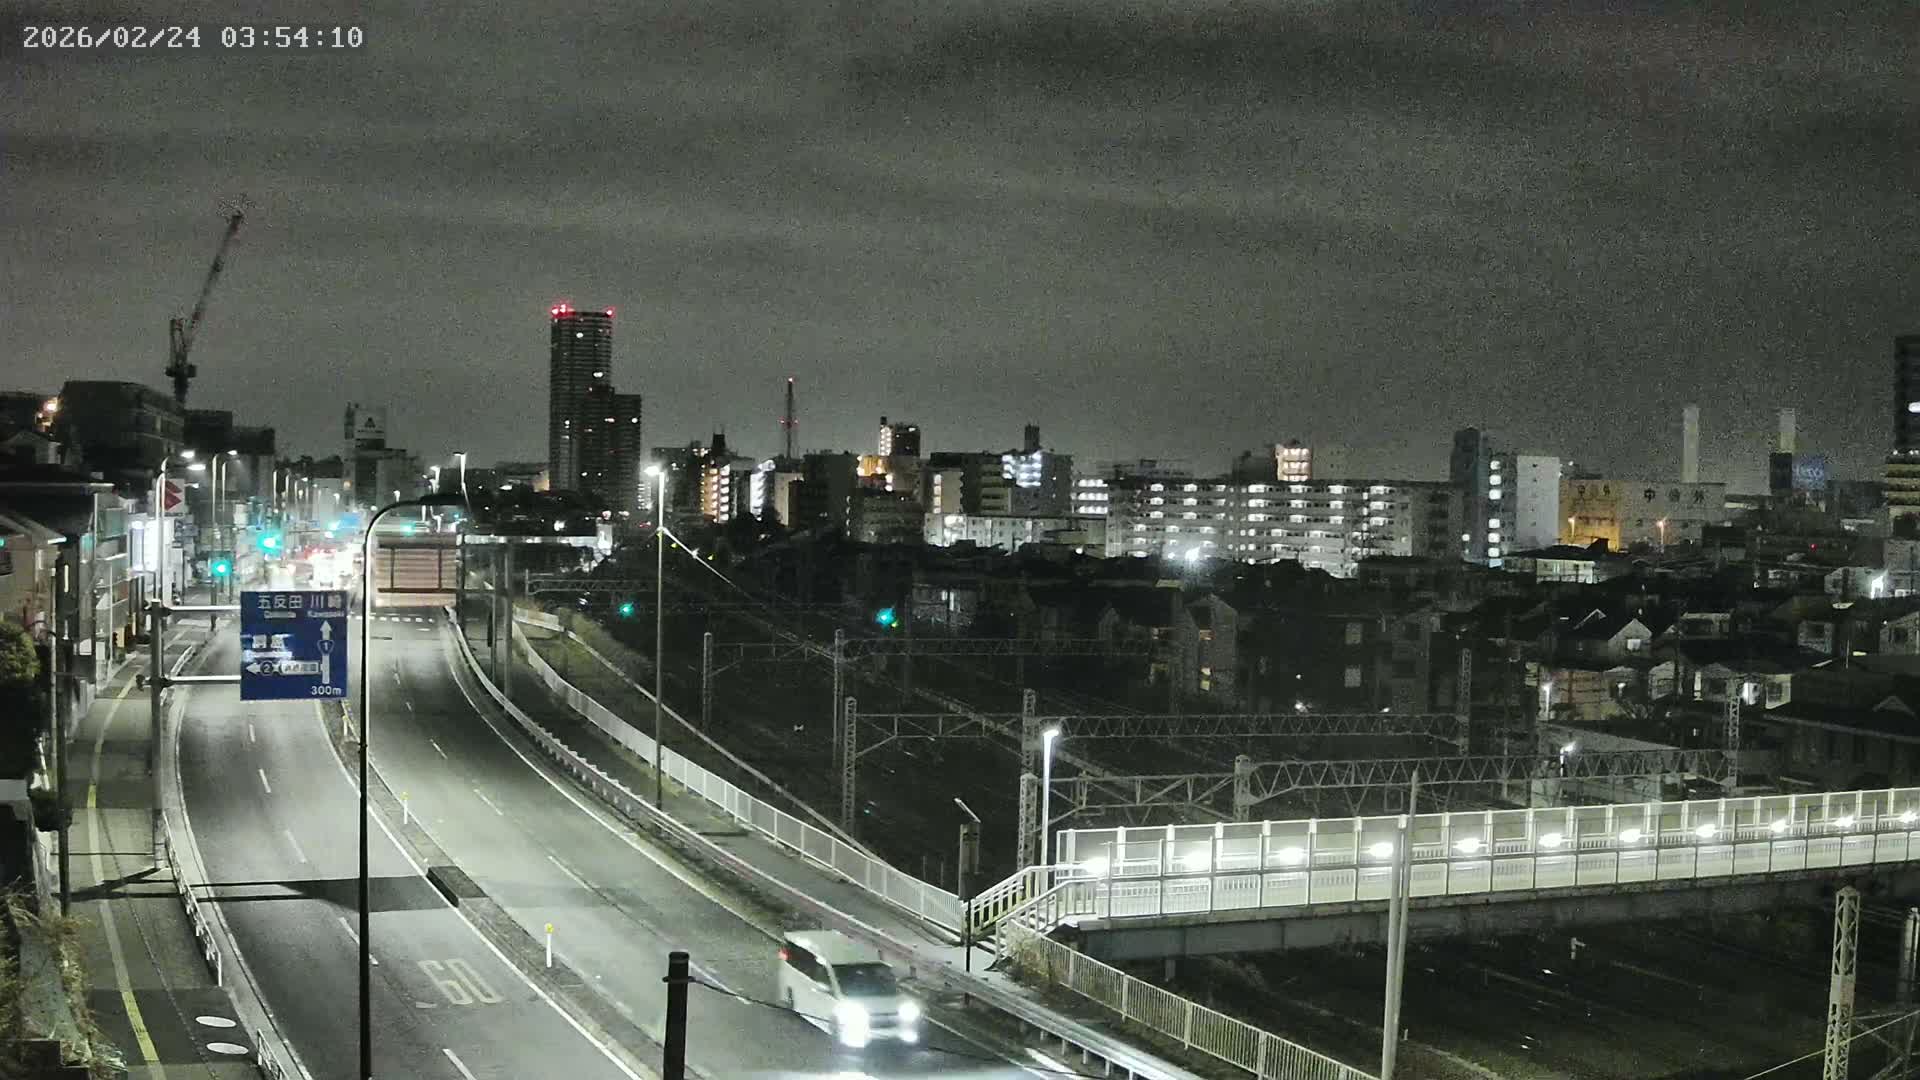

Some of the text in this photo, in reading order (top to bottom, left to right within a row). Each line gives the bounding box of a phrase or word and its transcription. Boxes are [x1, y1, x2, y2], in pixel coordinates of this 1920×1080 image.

[257, 595, 303, 609] 五反田
[311, 685, 342, 696] 300m
[417, 958, 505, 1006] 60
